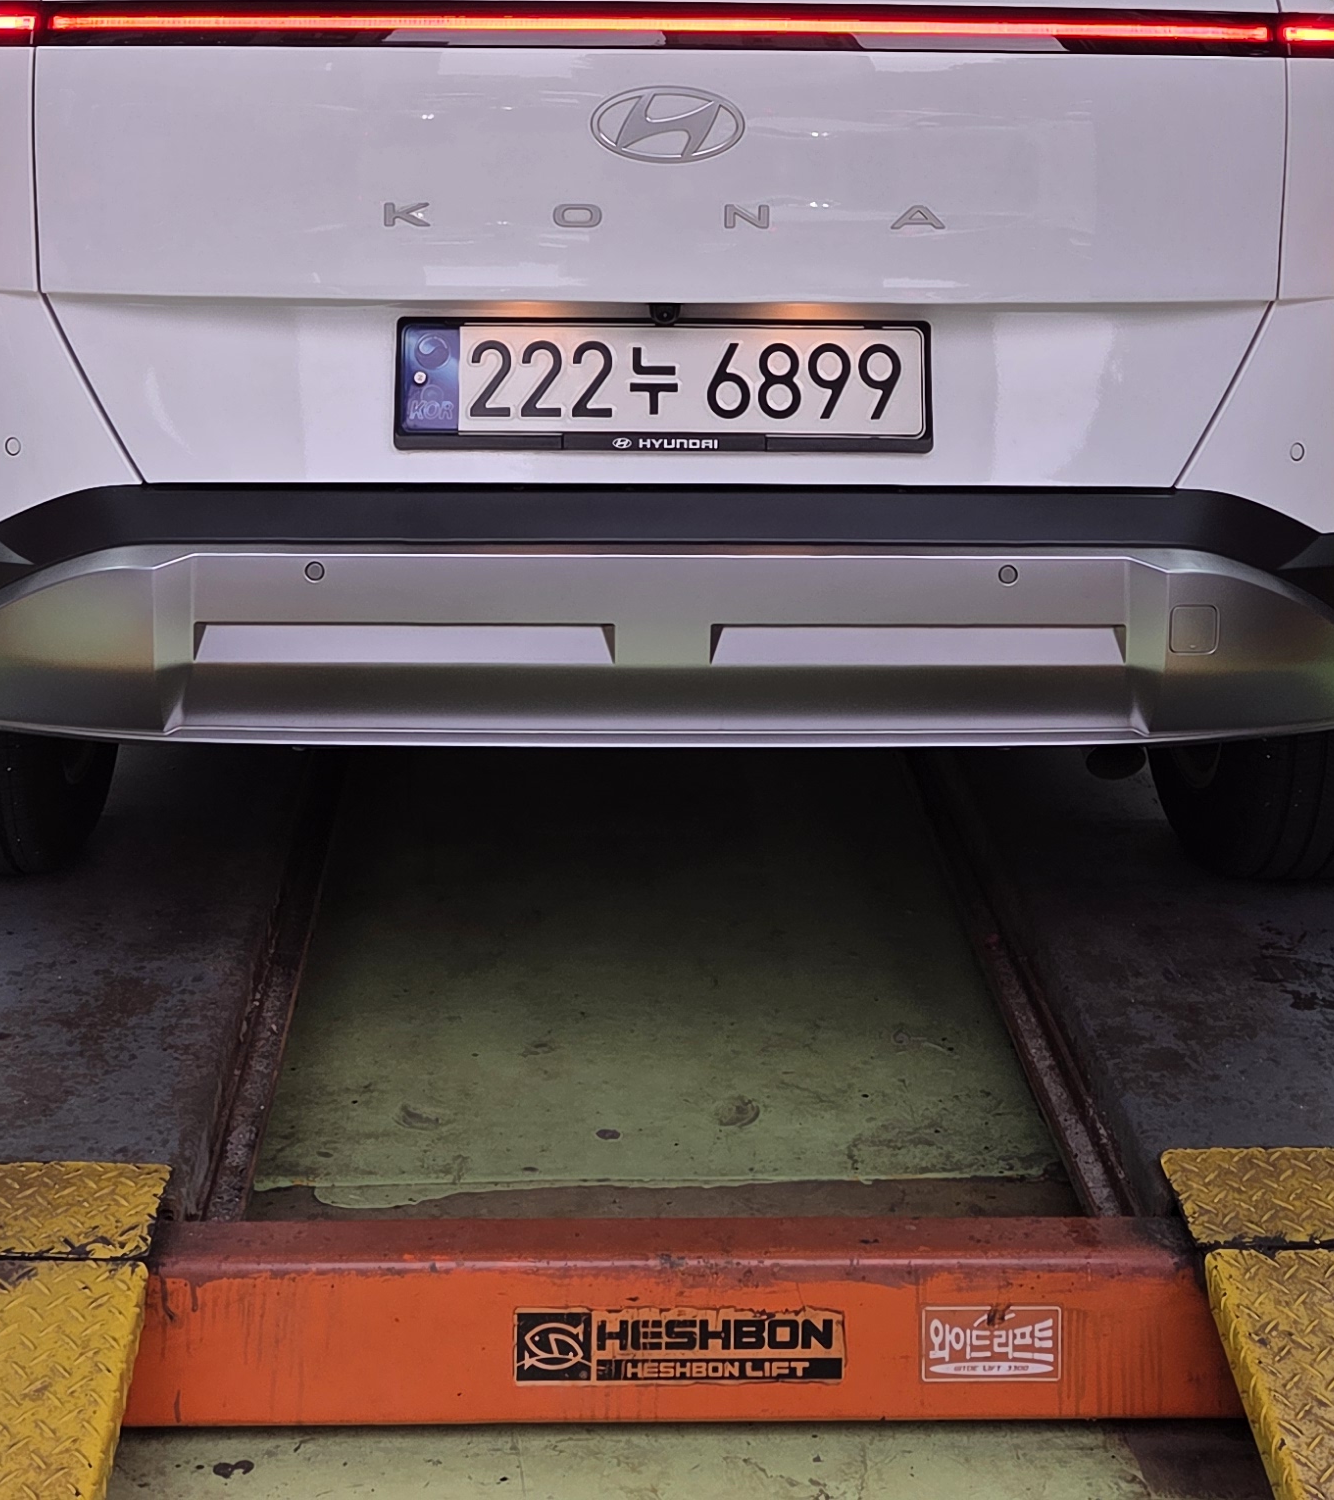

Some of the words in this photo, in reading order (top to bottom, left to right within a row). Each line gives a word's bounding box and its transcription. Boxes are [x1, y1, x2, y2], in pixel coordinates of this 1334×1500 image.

[383, 201, 945, 230] KONA
[468, 339, 679, 418] 222누
[705, 342, 902, 420] 6899
[408, 399, 455, 421] KOR
[638, 437, 719, 450] HYUNDAI
[596, 1318, 833, 1352] HESHBON
[928, 1317, 1055, 1363] 와이드리프트
[626, 1361, 739, 1378] HESHBON
[745, 1361, 810, 1377] LIFT
[953, 1364, 980, 1372] WIDE
